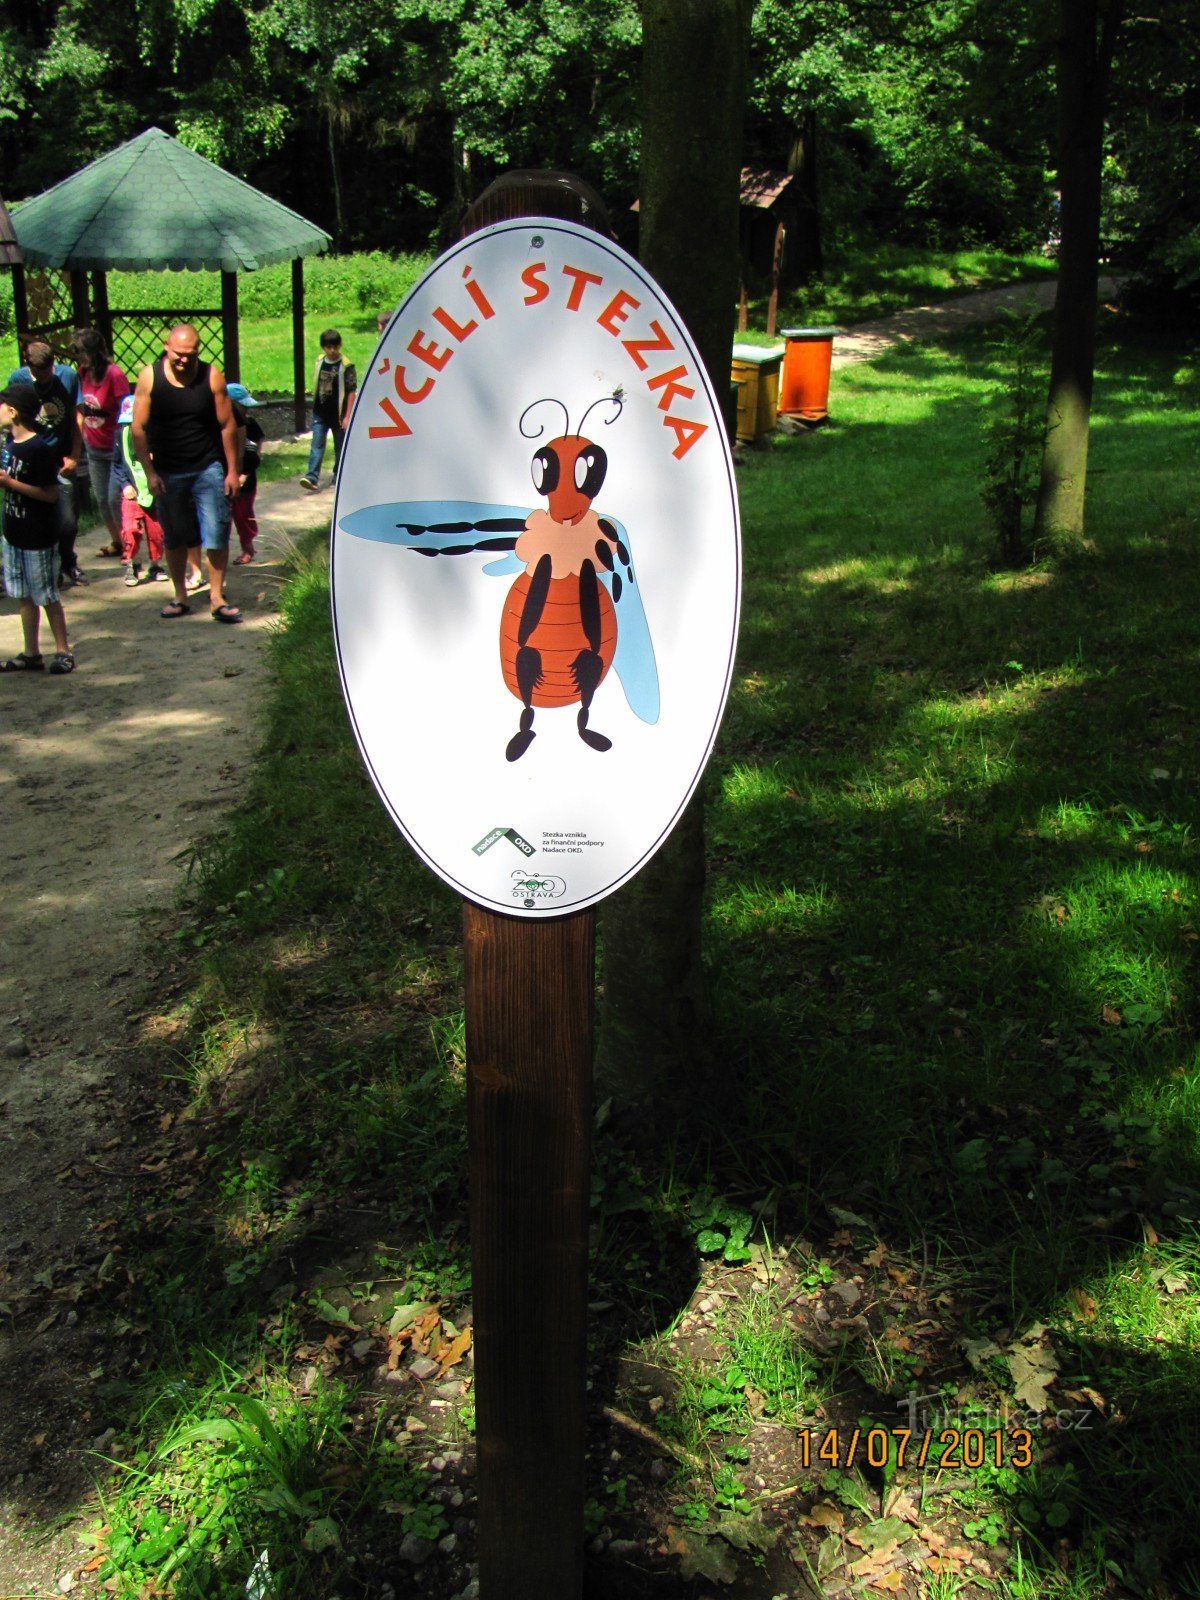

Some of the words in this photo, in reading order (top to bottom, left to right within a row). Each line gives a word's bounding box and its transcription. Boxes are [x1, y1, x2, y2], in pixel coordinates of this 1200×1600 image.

[368, 265, 496, 439] VČELÍ
[521, 262, 709, 461] STEZKA
[476, 829, 502, 853] nadace
[514, 837, 532, 854] OKD
[577, 840, 605, 848] podpory
[513, 878, 555, 892] ZOO
